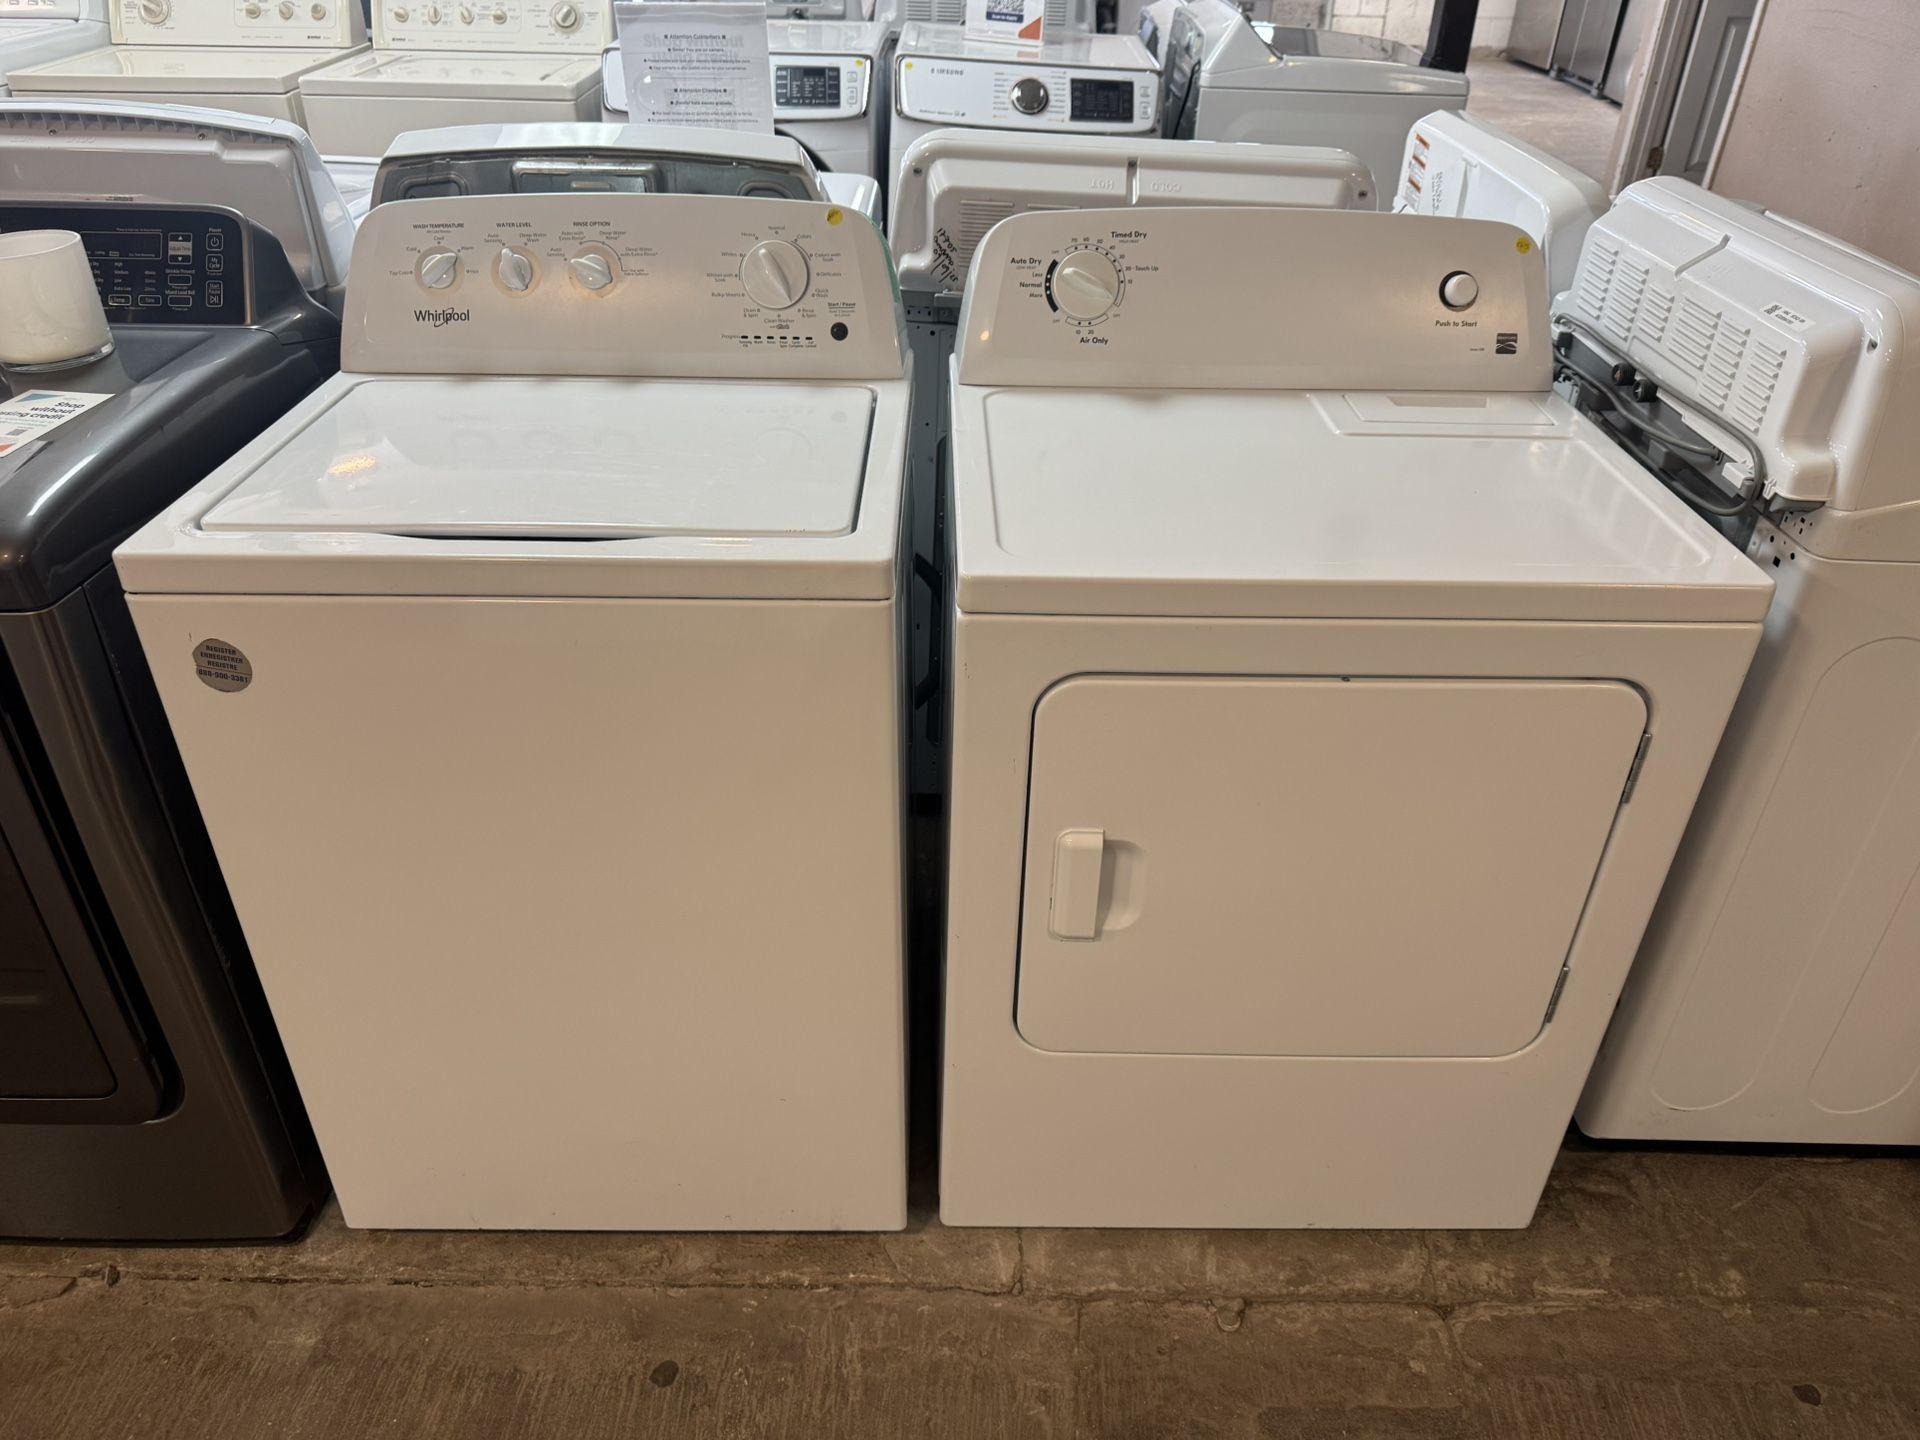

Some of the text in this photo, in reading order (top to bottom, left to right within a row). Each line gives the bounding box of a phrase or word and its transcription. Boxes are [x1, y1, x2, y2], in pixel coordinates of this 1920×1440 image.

[1111, 231, 1147, 239] Timed Dry
[1029, 257, 1042, 265] Dry
[413, 307, 470, 328] Whirlpool
[1092, 337, 1108, 345] Only
[30, 406, 76, 414] without
[205, 644, 237, 656] REGISTER
[207, 660, 238, 671] REGISTRE
